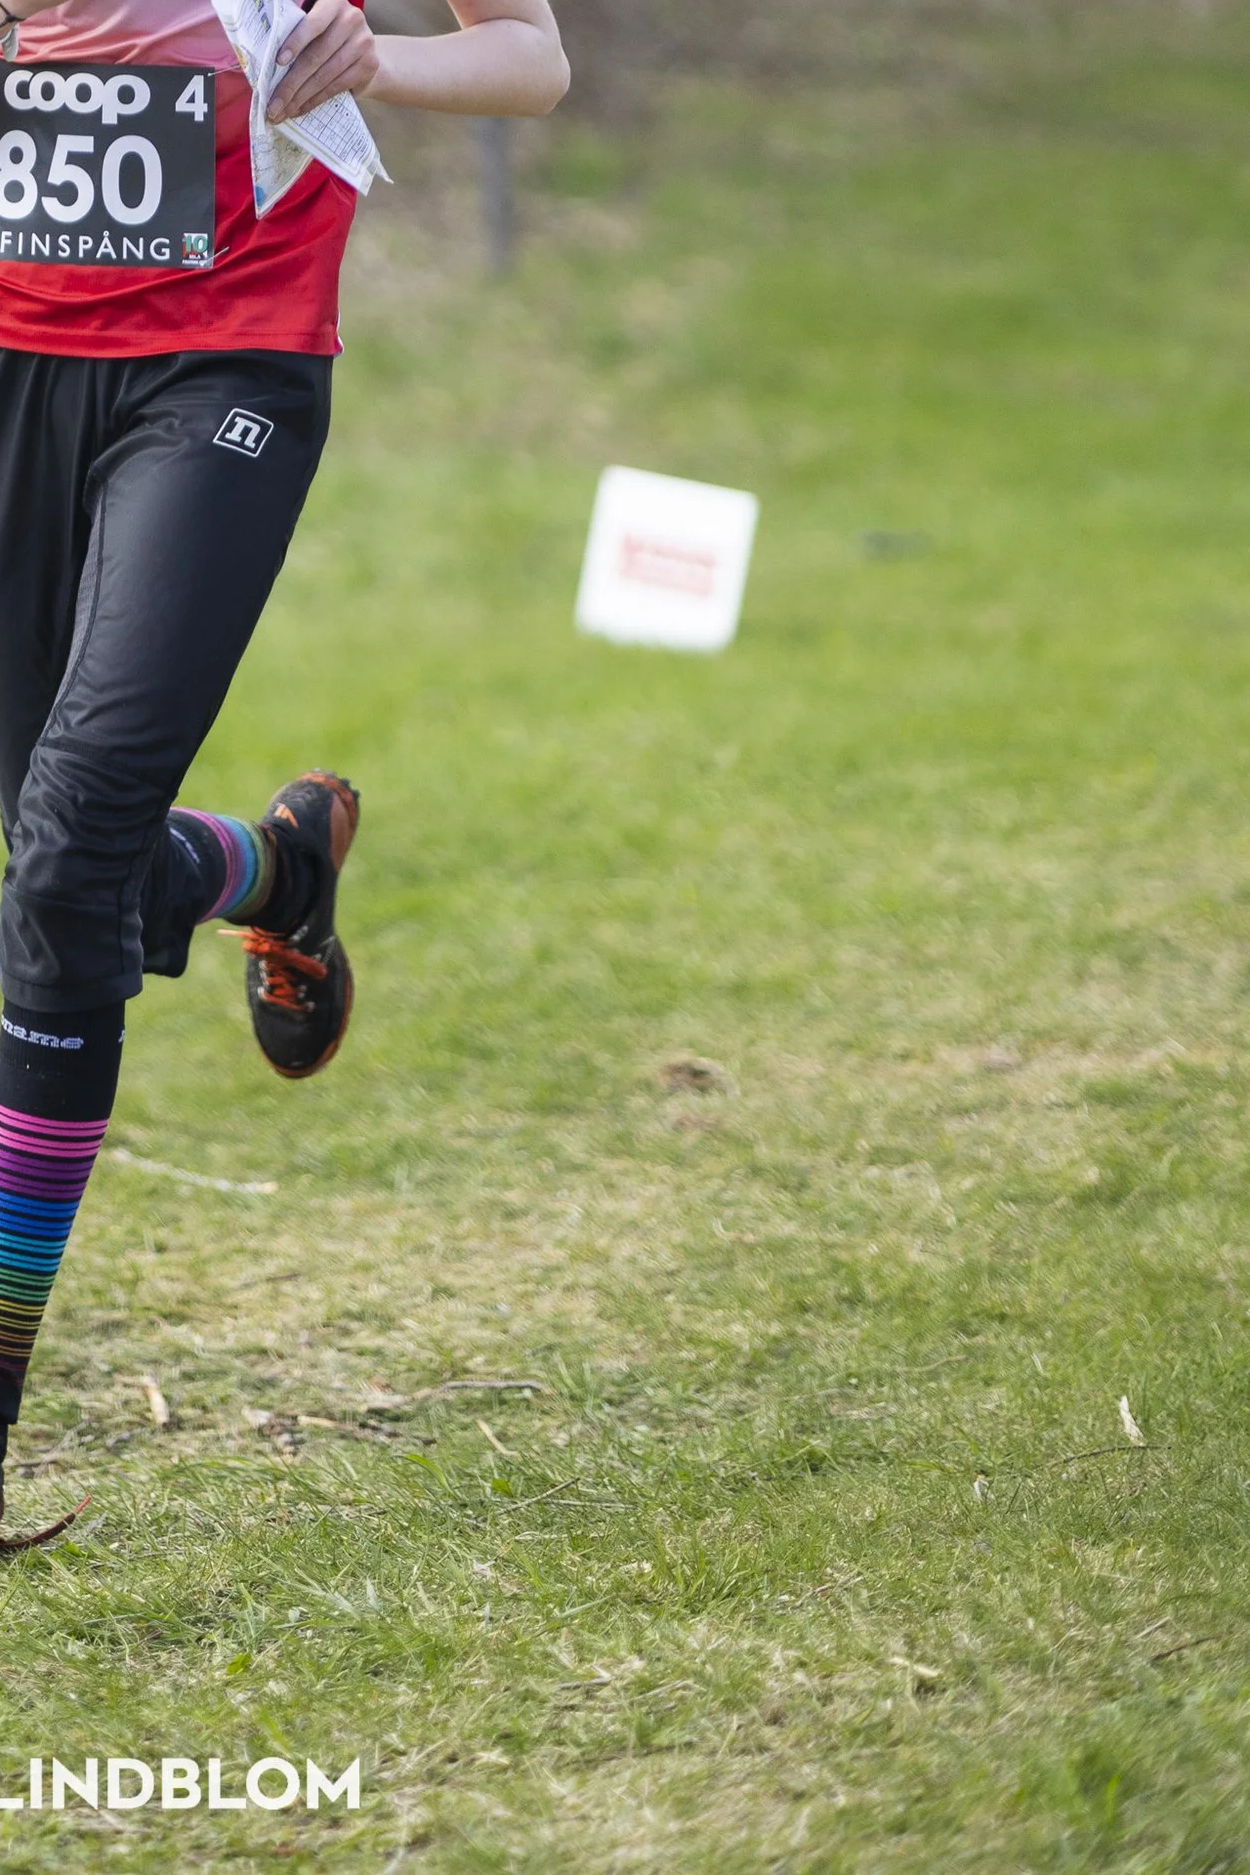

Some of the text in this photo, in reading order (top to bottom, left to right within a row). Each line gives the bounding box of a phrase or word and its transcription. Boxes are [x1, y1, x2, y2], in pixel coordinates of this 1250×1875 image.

[4, 69, 151, 125] coop
[175, 74, 209, 122] 4
[0, 230, 171, 261] FINSPÅNG
[182, 235, 208, 253] 10
